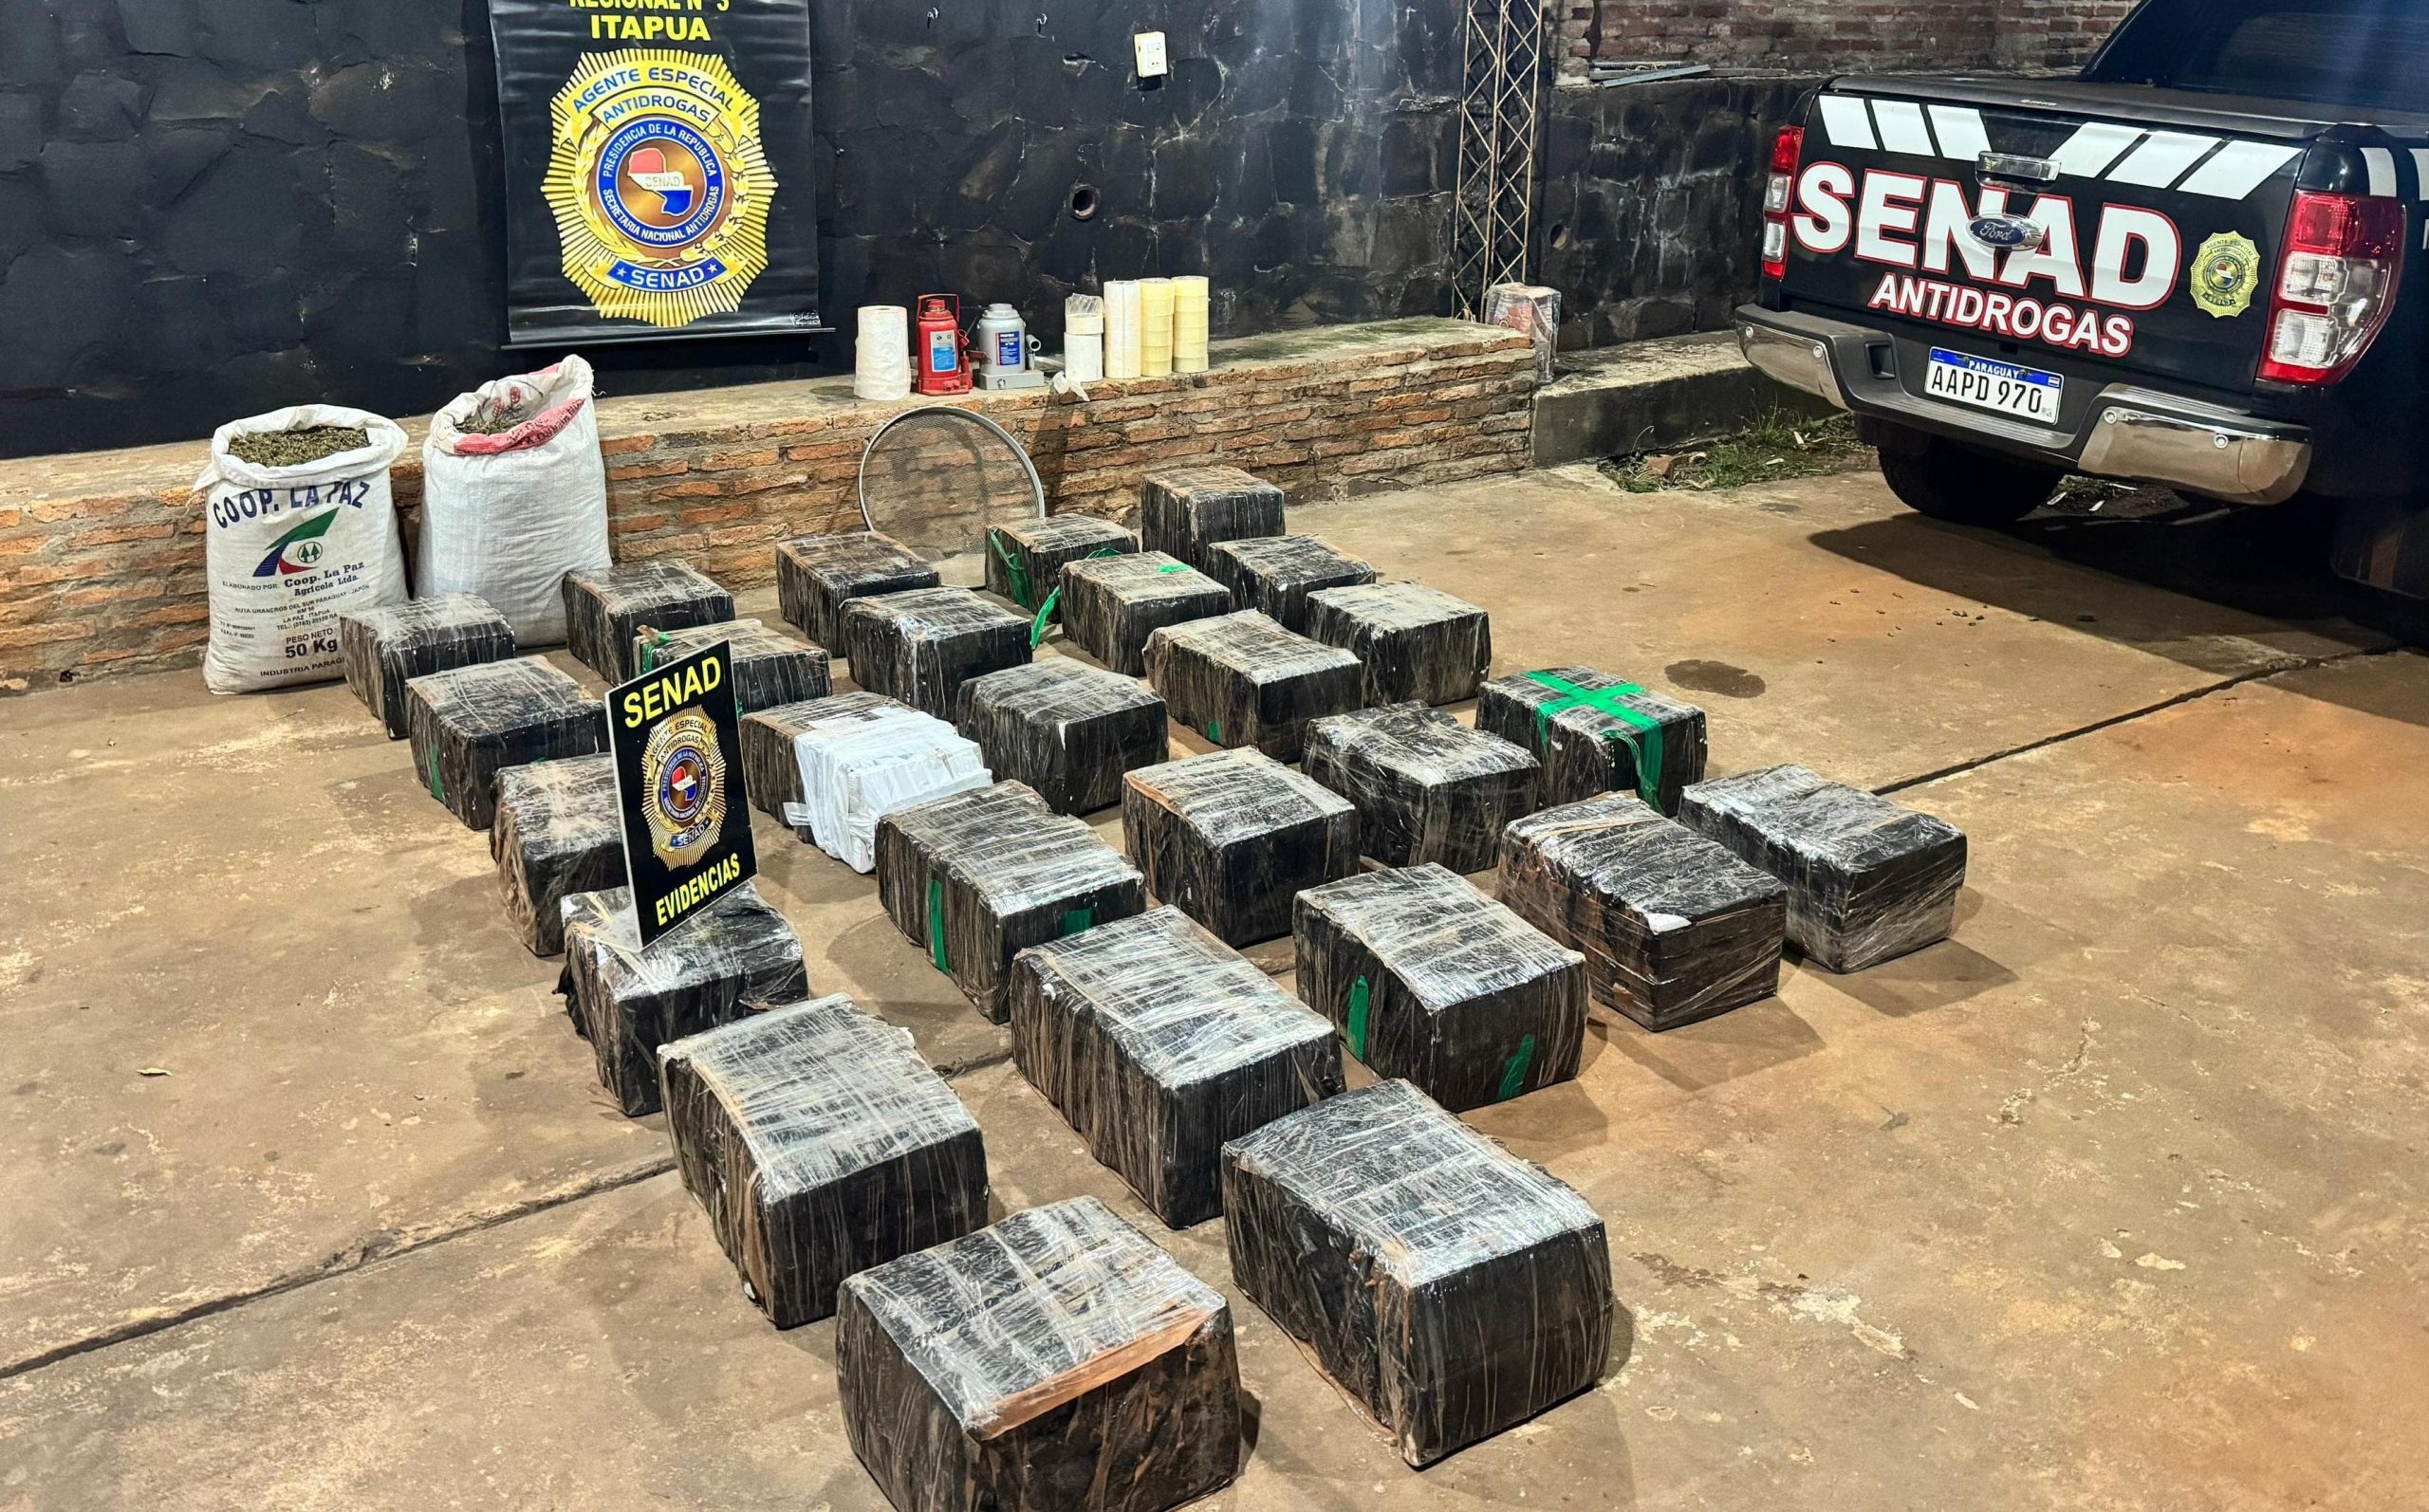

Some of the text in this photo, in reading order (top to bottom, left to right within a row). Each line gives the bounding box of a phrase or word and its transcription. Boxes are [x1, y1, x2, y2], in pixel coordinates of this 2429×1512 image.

[590, 14, 712, 41] ITAPUA
[572, 67, 734, 114] AGENTE ESPECIAL
[603, 95, 711, 123] ANTIDROGAS
[603, 123, 717, 177] PRESIDENCIA DE LA REPUBLICA
[603, 186, 719, 242] SECRETARIA NACIONAL ANTIDROGAS
[1791, 162, 2180, 310] SENAD
[1979, 221, 2013, 241] Ford
[630, 267, 705, 287] SENAD
[1869, 272, 2134, 358] ANTIDROGAS
[1968, 360, 2019, 378] PARAGUAY
[1931, 365, 2042, 414] AAPD 970
[213, 481, 370, 528] COOP. LA PAZ
[284, 562, 364, 588] Coop. La Paz
[294, 575, 360, 597] Agrícola Ltda.
[315, 592, 346, 604] PARAGUAY
[285, 637, 338, 658] 50 Kg
[286, 627, 334, 644] PESO NETO
[260, 656, 345, 676] INDUSTRIA PARAG
[623, 656, 721, 728] SENAD
[649, 719, 708, 760] AGENTE ESPECIAL
[659, 734, 700, 760] ANTIDROGAS
[677, 823, 706, 846] SENAD
[655, 853, 740, 926] EVIDENCIAS
